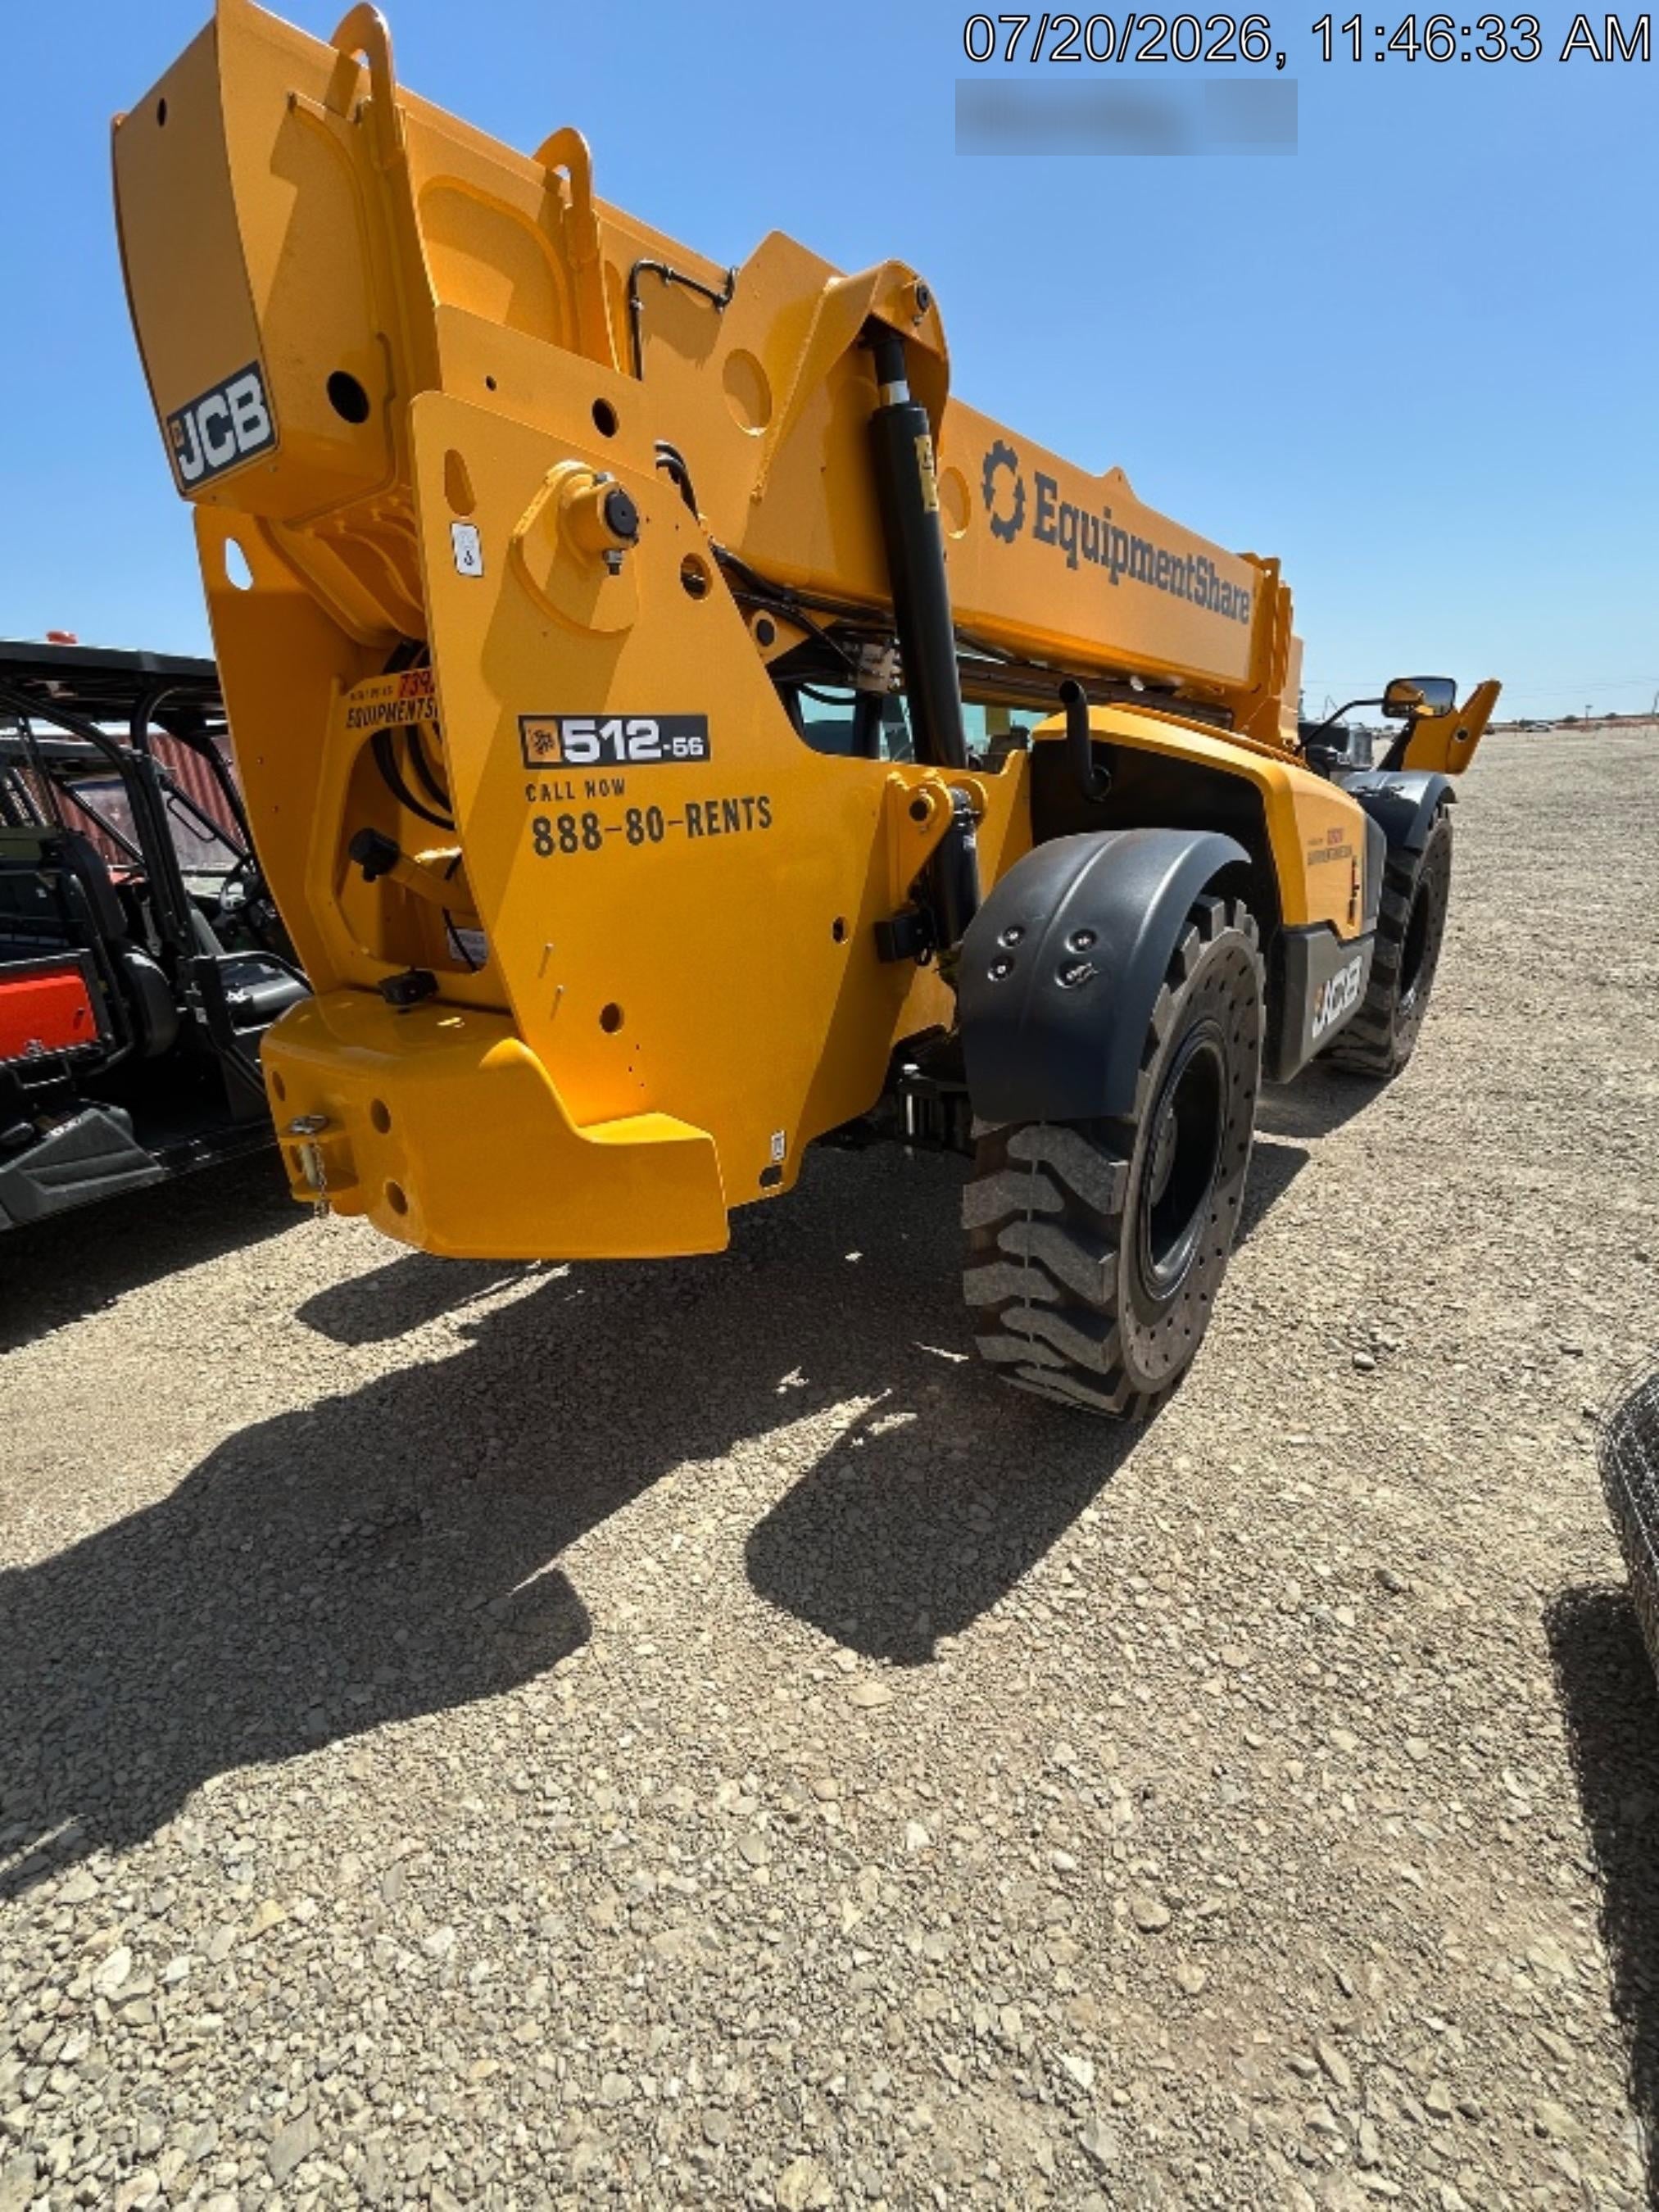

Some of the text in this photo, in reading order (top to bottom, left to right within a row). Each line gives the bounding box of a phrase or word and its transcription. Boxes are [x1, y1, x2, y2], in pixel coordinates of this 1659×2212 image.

[178, 373, 271, 480] JCB
[1032, 470, 1250, 625] EquipmentShare
[525, 777, 626, 802] CALL NOW
[532, 795, 773, 858] 888-80-RENTS
